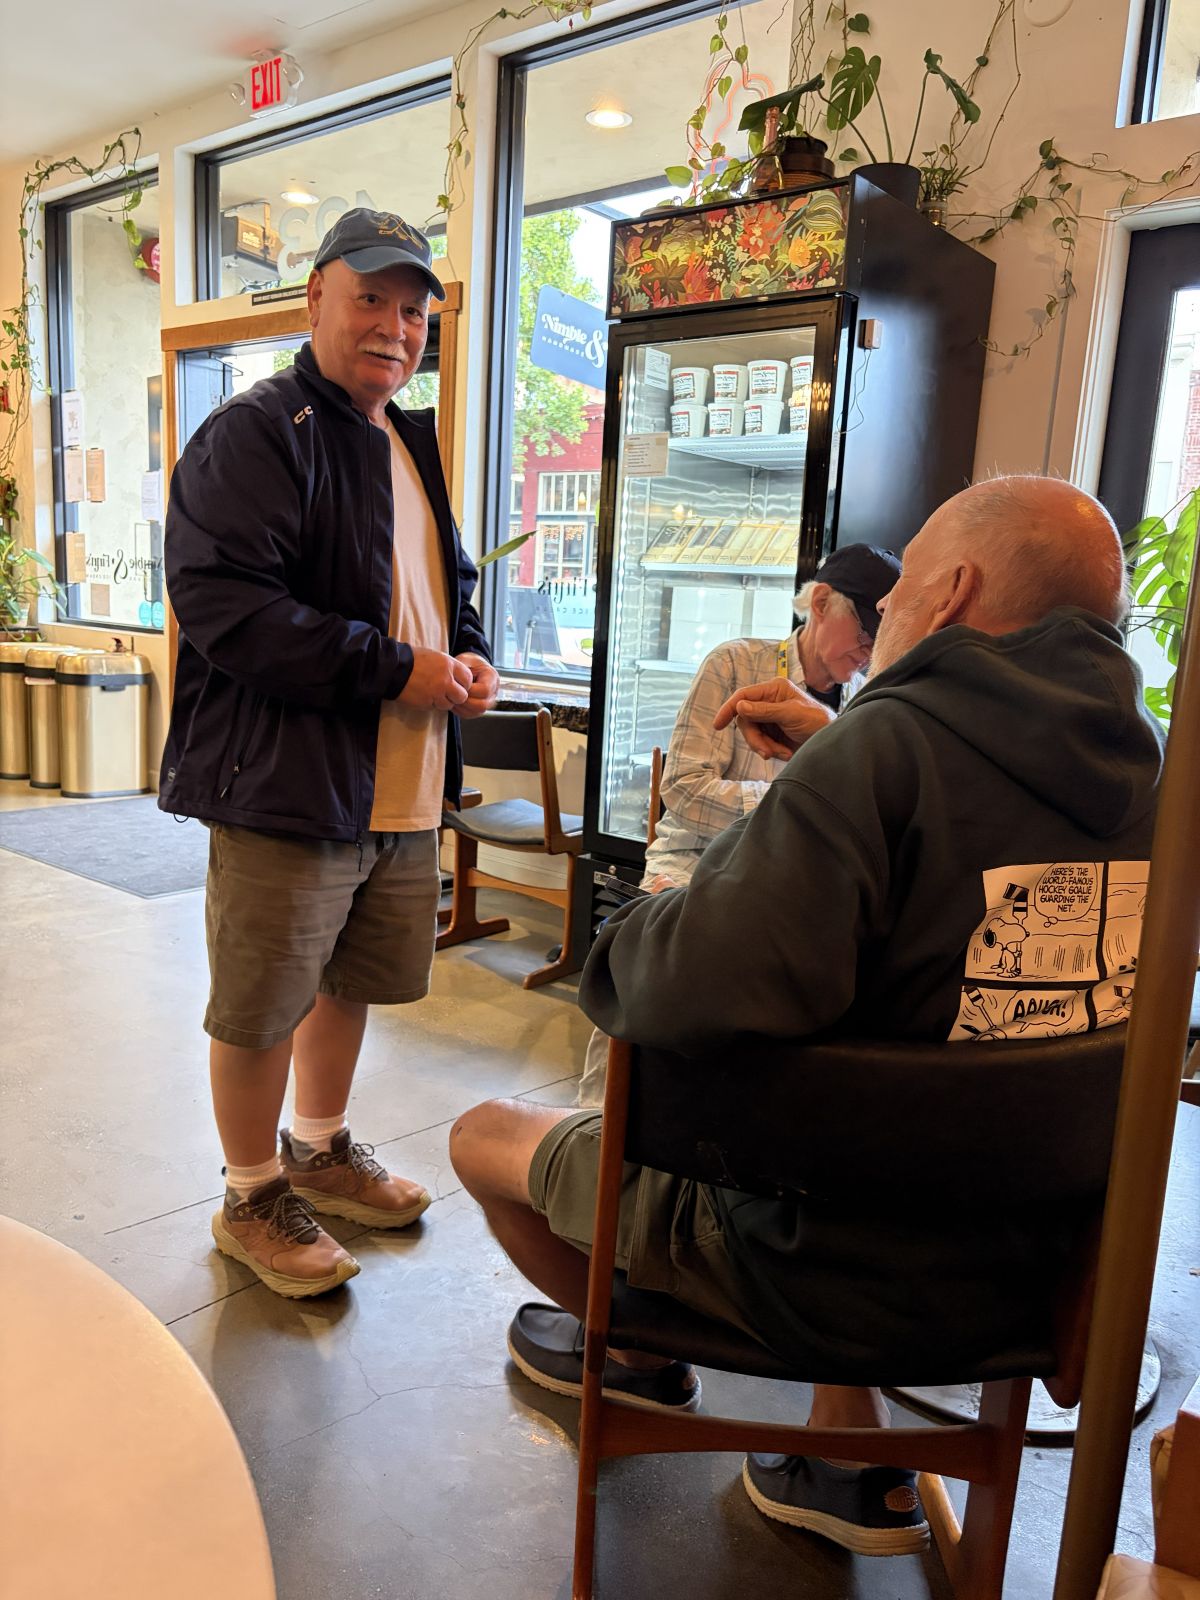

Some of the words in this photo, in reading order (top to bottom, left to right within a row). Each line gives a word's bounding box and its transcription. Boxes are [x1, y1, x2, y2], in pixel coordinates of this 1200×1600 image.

[251, 57, 282, 110] EXIT
[541, 313, 588, 345] Nimble
[585, 329, 608, 369] &
[1051, 866, 1074, 876] HERE'S
[1076, 867, 1089, 876] THE
[1043, 876, 1094, 885] WORLD-FAMOUS
[1039, 885, 1067, 894] HOCKEY
[1068, 886, 1092, 894] GOALIE
[1040, 895, 1075, 904] GUARDING
[1077, 895, 1089, 904] THE
